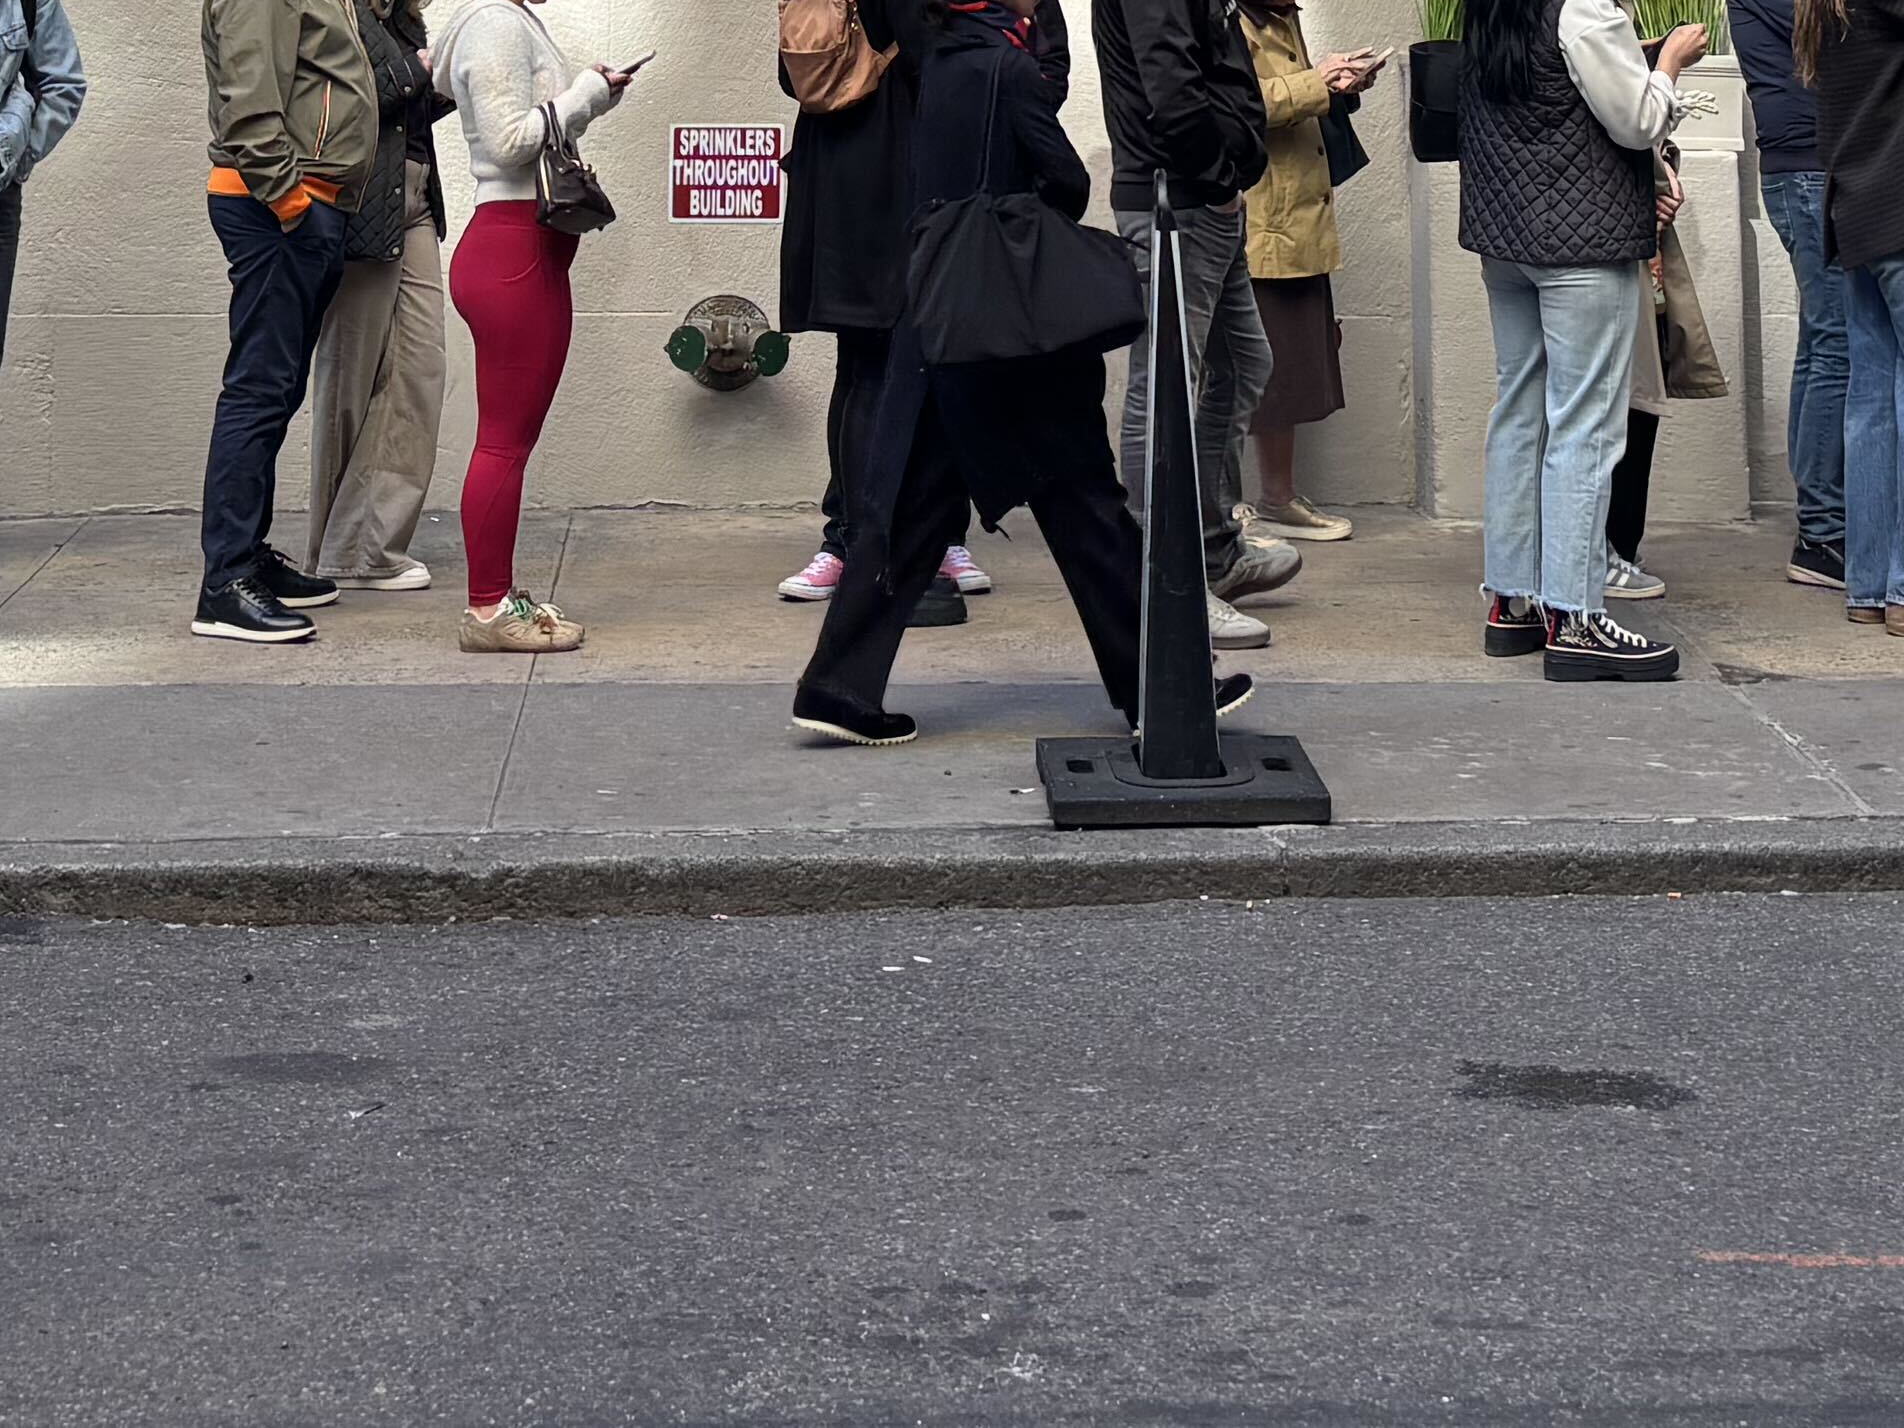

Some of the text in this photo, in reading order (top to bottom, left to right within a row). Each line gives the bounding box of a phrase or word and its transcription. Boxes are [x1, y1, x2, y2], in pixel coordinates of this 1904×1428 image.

[679, 128, 775, 156] SPRINKLERS
[673, 158, 780, 187] THROUGHOUT
[689, 188, 763, 217] BUILDING
